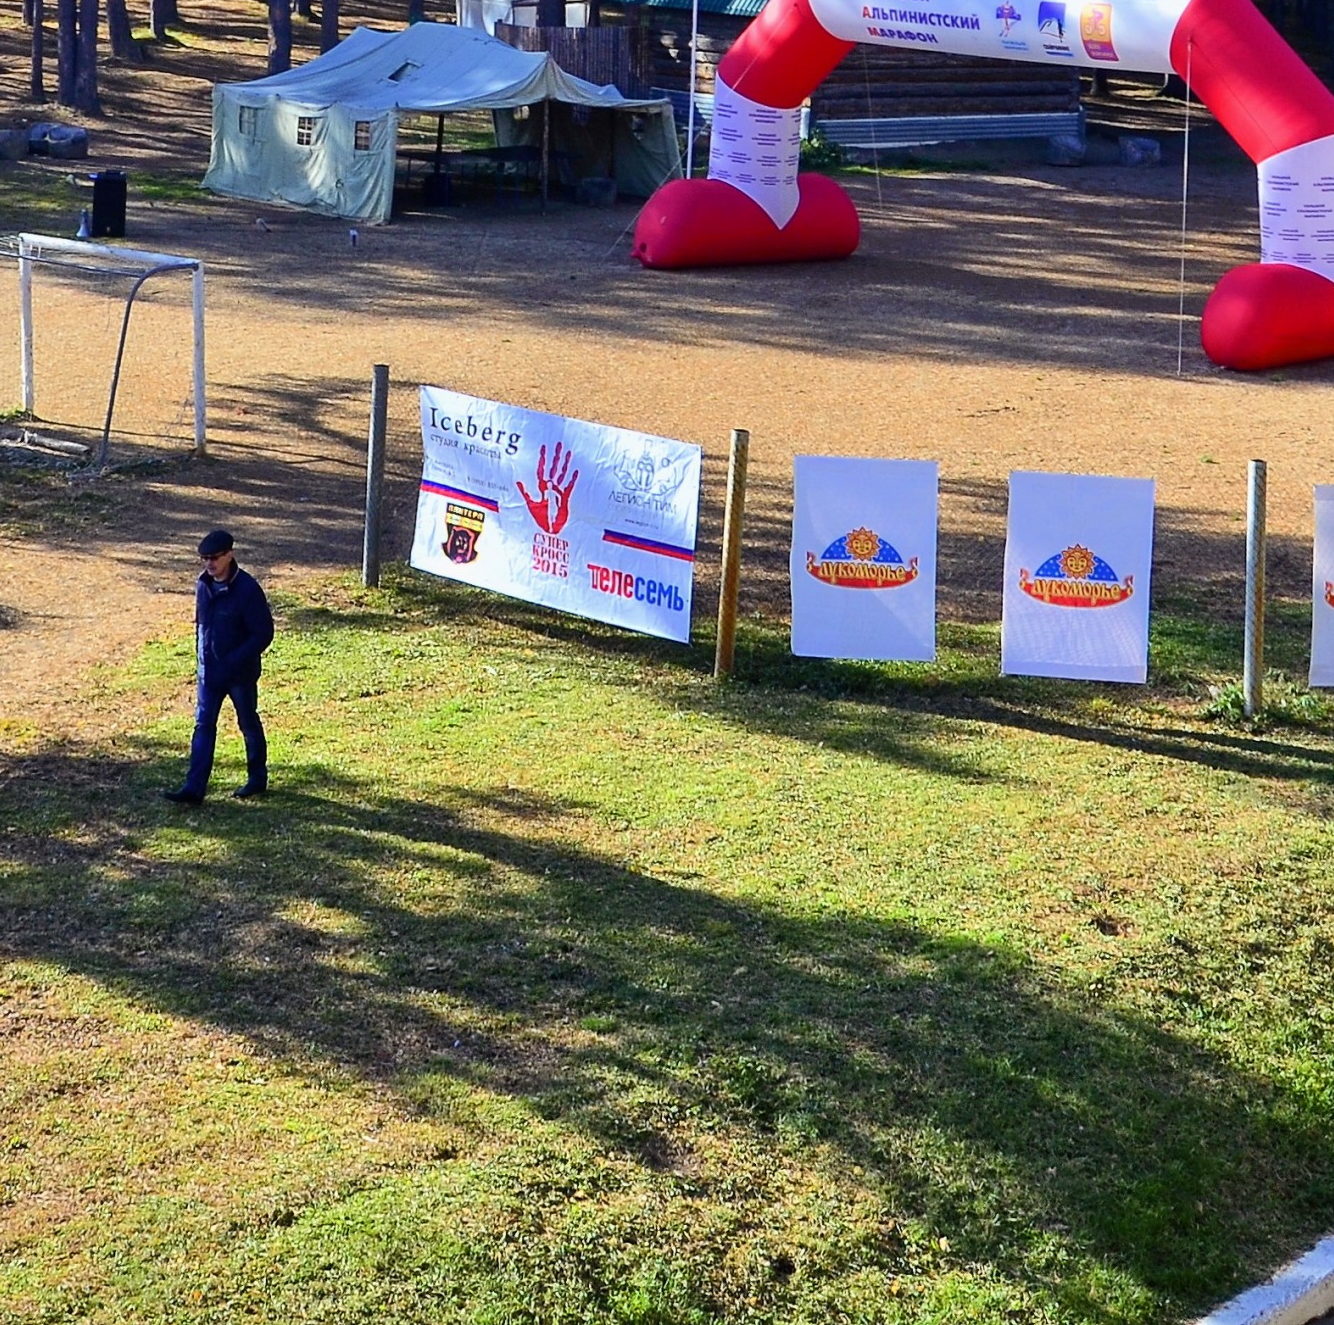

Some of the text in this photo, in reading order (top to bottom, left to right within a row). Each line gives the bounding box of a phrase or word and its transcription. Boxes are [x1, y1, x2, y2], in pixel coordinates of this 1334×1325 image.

[862, 6, 981, 30] АЛЬПИНИСТСКИЙ
[867, 27, 939, 44] МАРАФОН
[430, 407, 522, 456] Iceberg
[533, 533, 569, 551] СУПЕР
[532, 544, 570, 565] КРОСС
[532, 557, 568, 578] 2015
